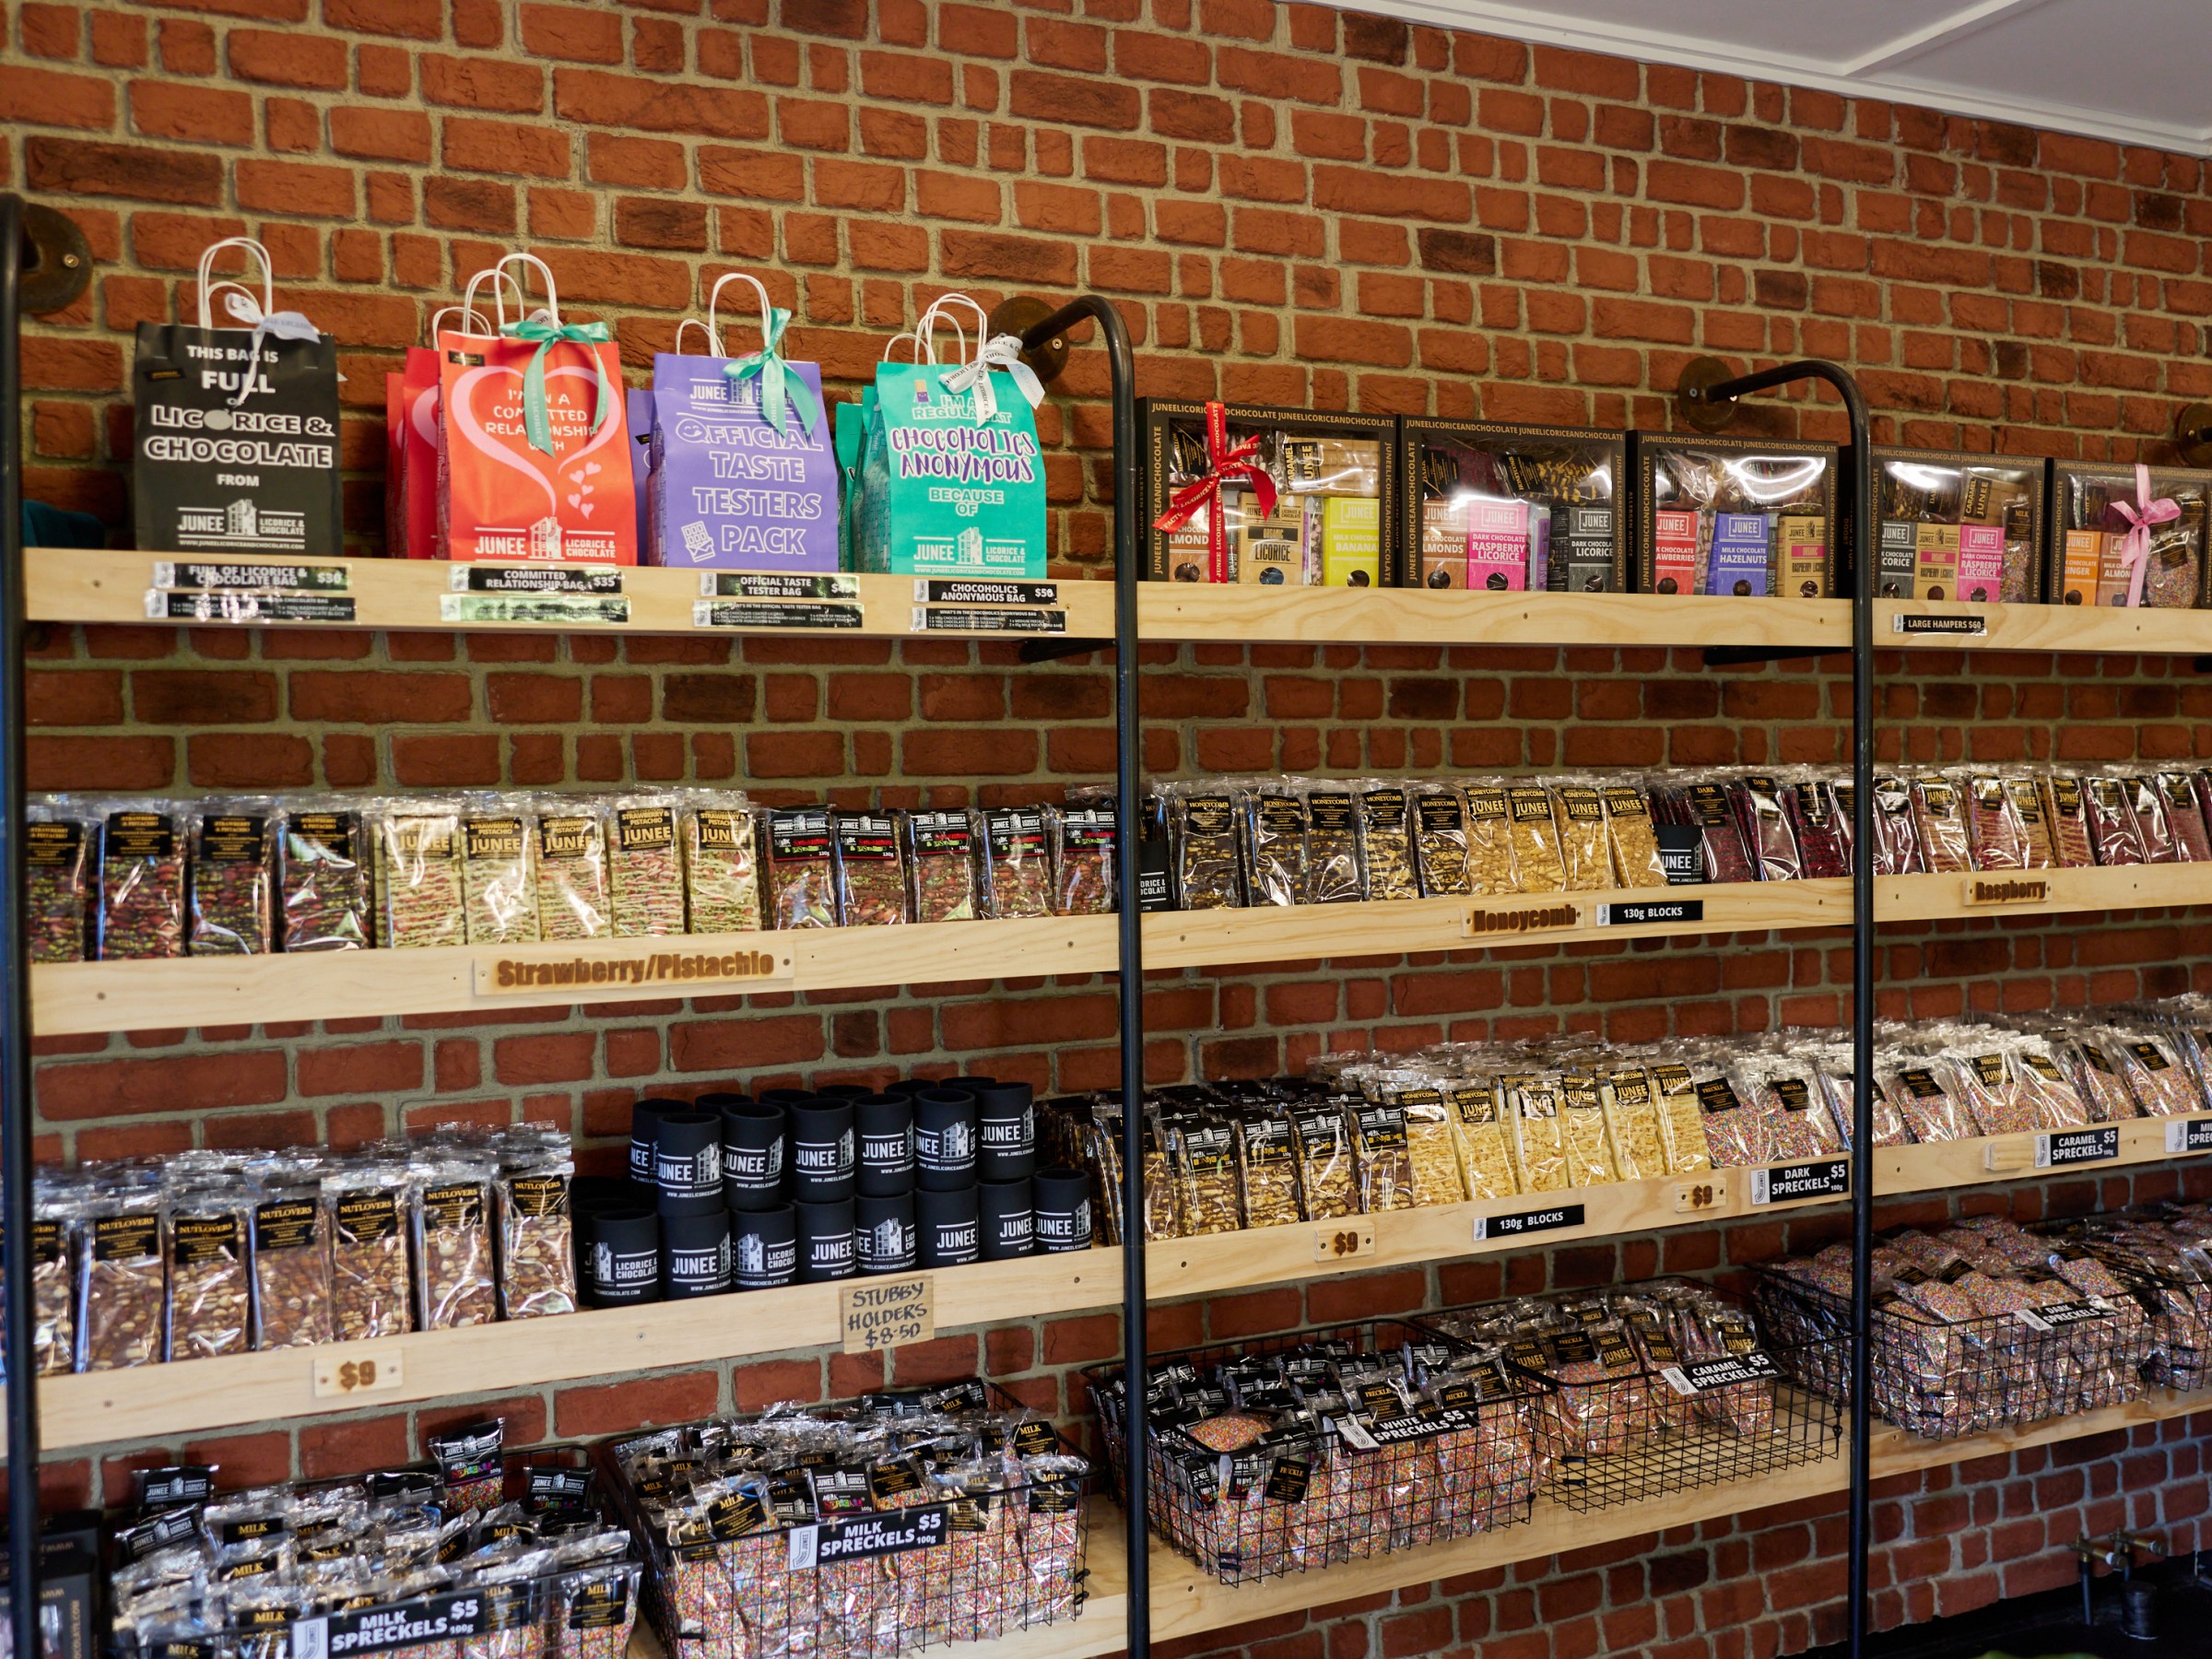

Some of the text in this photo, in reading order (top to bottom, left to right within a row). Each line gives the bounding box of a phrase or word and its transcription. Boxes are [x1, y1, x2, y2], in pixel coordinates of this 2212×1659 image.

[187, 346, 279, 363] THIS BAG IS
[202, 371, 276, 394] FULL
[559, 393, 571, 405] A
[689, 384, 728, 401] JUNEE
[1406, 419, 1624, 441] JUNEELICORICEANDCHOCOLATE JUNEELICORICEANDCHOCOLATE
[889, 426, 1038, 456] CHOCOHOLICS
[1641, 435, 1837, 453] JUNEELICORICEANDCHOCOLATE JUNEELICORICEANDCHOCOLATE
[144, 436, 333, 468] CHOCOLATE
[709, 451, 806, 483] TASTE
[900, 452, 1036, 484] ANONYMOUS
[217, 474, 260, 487] FROM
[929, 488, 1005, 504] BECAUSE
[1964, 477, 1977, 514] CARAMEL
[692, 487, 822, 520] TESTERS
[955, 502, 978, 516] OF
[1383, 441, 1392, 582] JUNEELICORICEANDCHOCOLATE
[1409, 441, 1418, 581] JUNEELICORICEANDCHOCOLATE
[177, 514, 225, 533] JUNEE
[259, 517, 305, 528] LICORICE &
[1582, 514, 1608, 527] JUNEE
[1642, 455, 1651, 587] JUNEELICORICEANDCHOCOLATE
[1732, 521, 1759, 534] JUNEE
[259, 525, 305, 535] CHOCOLATE
[475, 535, 526, 555] JUNEE
[566, 538, 616, 548] LICORICE &
[721, 524, 807, 556] PACK
[1472, 533, 1525, 543] DARK CHOCOLATE
[566, 547, 616, 559] CHOCOLATE
[913, 544, 955, 562] JUNEE
[985, 546, 1026, 556] LICORICE &
[1254, 543, 1290, 562] LICORICE
[1472, 542, 1525, 554] RASPBERRY
[1885, 550, 1914, 559] CHOCOLATE
[985, 554, 1026, 564] CHOCOLATE
[1477, 551, 1520, 561] LICORICE
[1719, 554, 1767, 564] HAZELNUTS
[1961, 552, 2002, 561] DARK CHOCOLATE
[221, 566, 238, 576] OF
[240, 567, 296, 577] LICORICE
[298, 568, 308, 578] &
[1960, 559, 2002, 571] RASPBERRY
[195, 574, 298, 586] CHOCOLATE BAG
[503, 570, 567, 581] COMMITTED
[1964, 567, 1997, 579] LICORICE
[486, 579, 583, 590] RELATIONSHIP BAG
[593, 576, 616, 587] $35
[740, 576, 812, 587] OFFICIAL TASTE
[950, 583, 1018, 594] CHOCOHOLICS
[747, 586, 802, 596] TESTER BAG
[940, 592, 1026, 603] ANONYMOUS BAG
[1908, 618, 1983, 631] LARGE HAMPERS $60
[1697, 786, 1716, 794] DARK
[630, 817, 664, 826] PISTACHIO
[623, 827, 672, 843] JUNEE
[1976, 880, 2047, 902] Raspberry
[1474, 903, 1577, 933] Honeycomb
[1623, 906, 1683, 920] 130g BLOCKS
[981, 1125, 1021, 1142] JUNEE
[2103, 1130, 2116, 1146] $5
[2058, 1135, 2097, 1148] CARAMEL
[862, 1140, 905, 1159] JUNEE
[2052, 1144, 2103, 1161] SPRECKELS
[723, 1156, 766, 1173] JUNEE
[795, 1150, 836, 1167] JUNEE
[1784, 1167, 1810, 1179] DARK
[1830, 1164, 1846, 1179] $5
[1771, 1176, 1830, 1195] SPRECKELS
[1830, 1183, 1843, 1192] 100g
[427, 1187, 478, 1200] NUTLOVERS
[259, 1206, 313, 1220] NUTLOVERS
[340, 1200, 393, 1214] NUTLOVERS
[98, 1217, 156, 1231] NUTLOVERS
[1035, 1219, 1073, 1236] JUNEE
[1500, 1211, 1564, 1230] 130g BLOCKS
[180, 1222, 233, 1235] NUTLOVERS
[936, 1228, 976, 1249] JUNEE
[1335, 1230, 1359, 1257] $9
[672, 1255, 718, 1275] JUNEE
[853, 1282, 924, 1308] STUBBY
[2042, 1308, 2100, 1324] SPRECKELS
[2044, 1304, 2073, 1314] DARK
[847, 1302, 928, 1332] HOLDERS
[1604, 1347, 1632, 1361] JUNEE
[1749, 1354, 1770, 1368] $5
[1692, 1360, 1743, 1377] CARAMEL
[1692, 1367, 1759, 1388] SPRECKELS
[1445, 1391, 1469, 1401] FRECKLE
[942, 1398, 963, 1412] MILK
[1443, 1409, 1465, 1422] $5
[1019, 1424, 1041, 1435] MILK
[1373, 1419, 1451, 1441] SPRECKELS
[1379, 1417, 1421, 1430] WHITE
[1453, 1422, 1472, 1430] 100g
[719, 1493, 746, 1511] MILK
[237, 1523, 269, 1535] MILK
[918, 1513, 942, 1531] $5
[493, 1526, 520, 1538] MILK
[844, 1521, 883, 1538] MILK
[820, 1528, 915, 1558] SPRECKELS
[916, 1535, 936, 1545] 100g
[233, 1562, 265, 1577] MILK
[254, 1609, 287, 1623] MILK
[450, 1599, 479, 1620] $5
[359, 1610, 407, 1630] MILK
[331, 1617, 448, 1653] SPRECKELS
[449, 1623, 475, 1635] 100g
